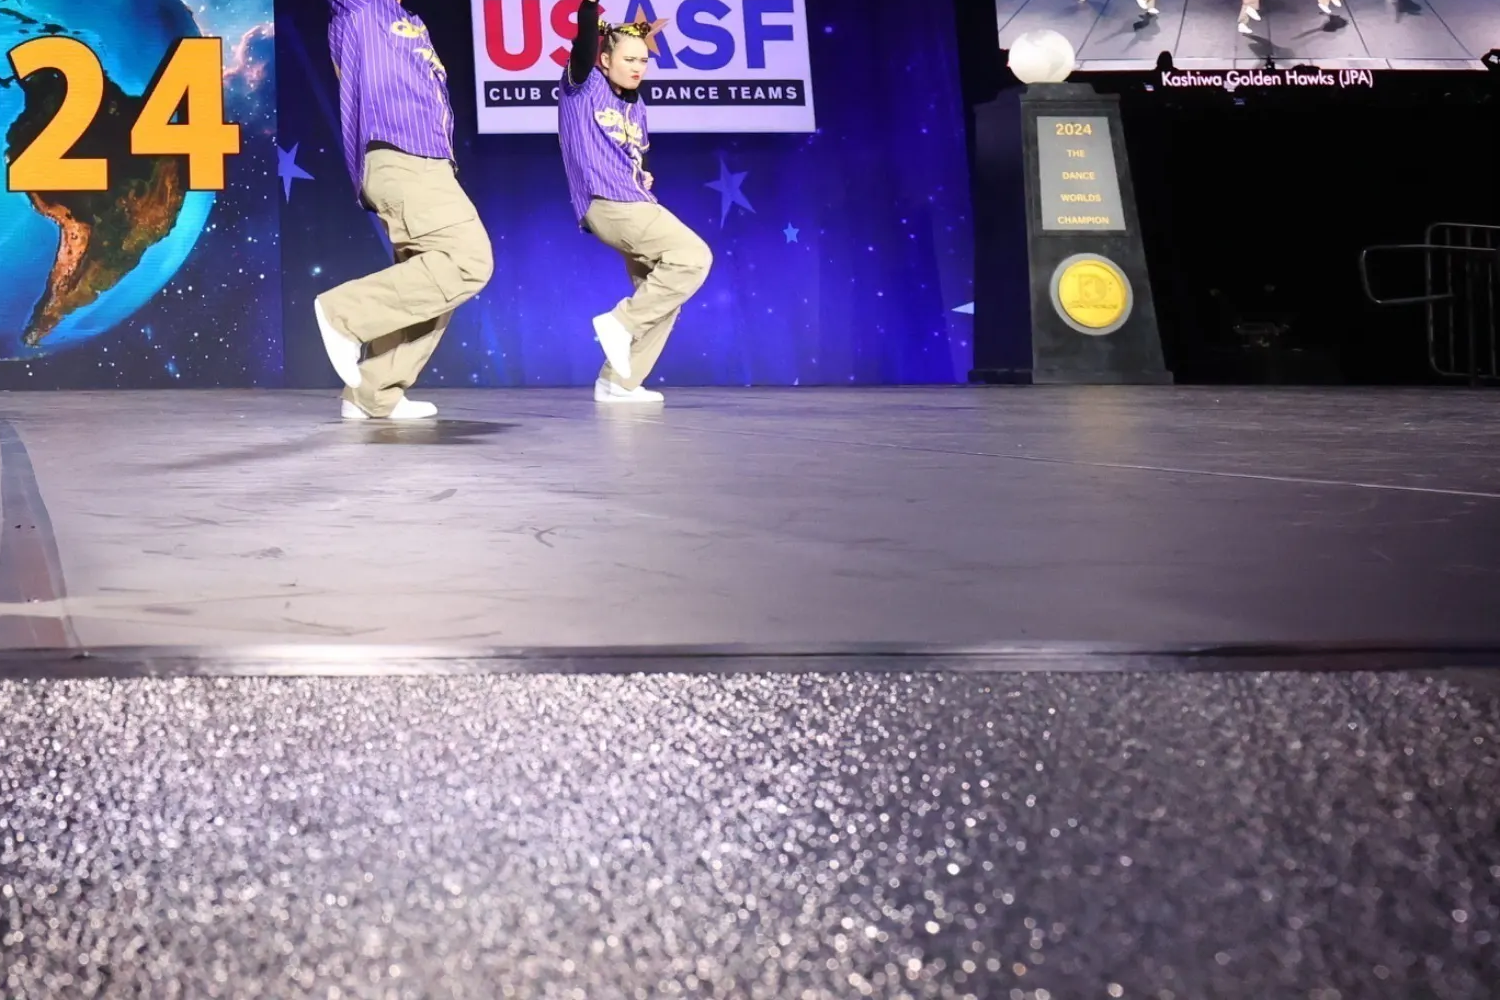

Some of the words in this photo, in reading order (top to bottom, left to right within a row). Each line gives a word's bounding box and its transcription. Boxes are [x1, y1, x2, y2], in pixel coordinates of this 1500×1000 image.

[1161, 71, 1222, 87] Kashiwa
[1226, 71, 1281, 87] Golden
[1285, 70, 1335, 86] Hawks
[1339, 69, 1373, 88] (JPA)
[489, 87, 542, 101] CLUB
[651, 86, 720, 100] DANCE
[728, 86, 798, 100] TEAMS
[1055, 123, 1093, 136] 2024
[1066, 149, 1085, 158] THE
[1062, 171, 1096, 180] DANCE
[1060, 194, 1102, 202] WORLDS
[1057, 216, 1110, 225] CHAMPION
